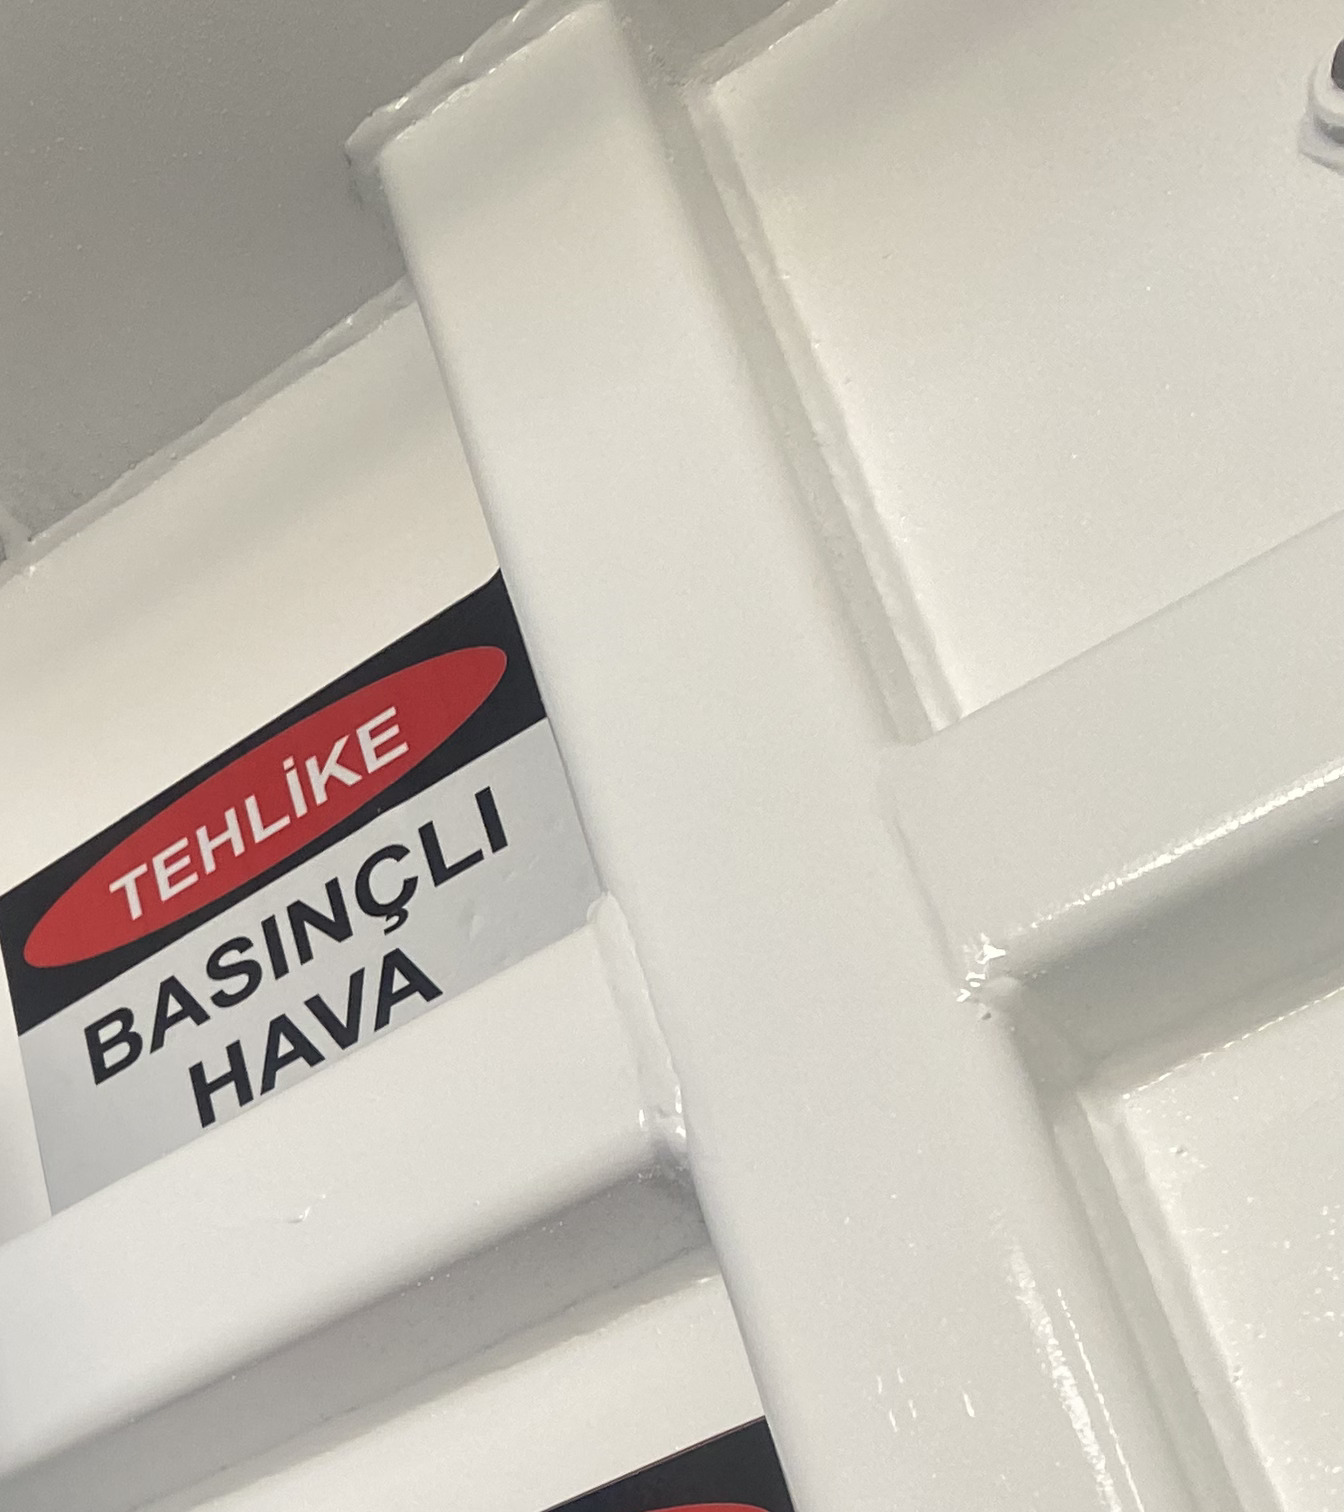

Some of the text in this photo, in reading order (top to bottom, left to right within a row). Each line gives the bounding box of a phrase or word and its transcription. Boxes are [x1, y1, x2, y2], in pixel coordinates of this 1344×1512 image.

[109, 706, 409, 921] TEHLİKE
[84, 786, 508, 1085] BASINÇLI
[189, 948, 443, 1128] HAVA
